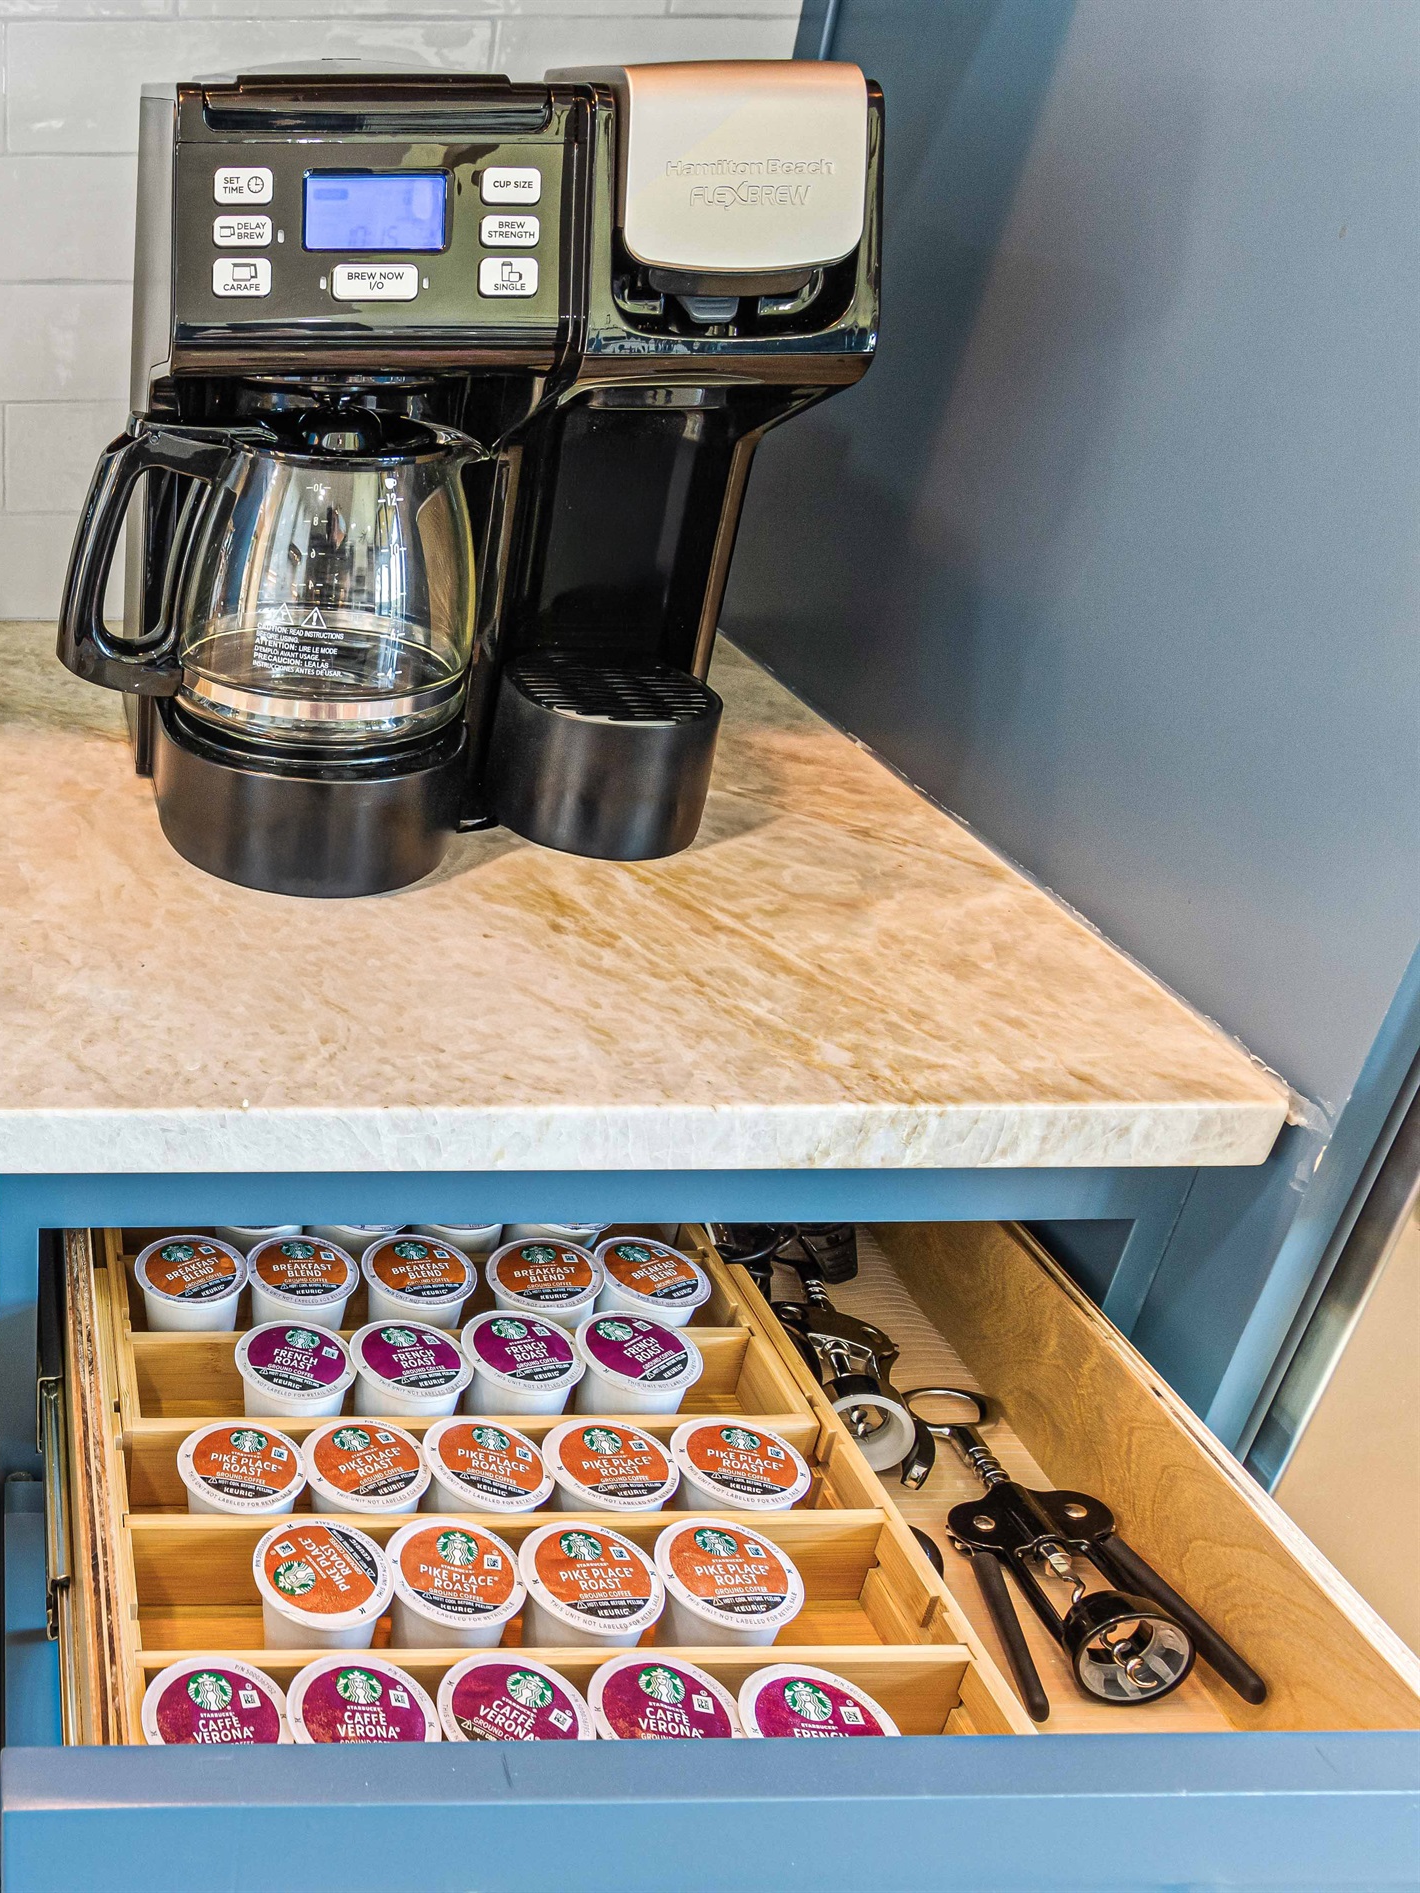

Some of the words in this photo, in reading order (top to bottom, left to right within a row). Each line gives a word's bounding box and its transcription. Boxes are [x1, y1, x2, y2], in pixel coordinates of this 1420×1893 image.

[666, 159, 763, 177] Hamilton
[766, 158, 835, 176] Beach
[223, 176, 240, 185] SET
[493, 180, 511, 189] CUP
[514, 180, 533, 189] SIZE
[223, 186, 244, 194] TIME
[689, 180, 811, 211] FLEXBREW
[236, 222, 267, 232] DELAY
[498, 221, 525, 230] BREW
[236, 230, 265, 240] BREW
[488, 230, 535, 240] STRENGTH
[347, 272, 376, 280] BREW
[379, 272, 404, 280] NOW
[223, 283, 260, 292] CARAFE
[369, 281, 384, 290] I/O
[494, 282, 526, 292] SINGLE
[386, 493, 396, 506] 12
[289, 628, 304, 636] READ
[304, 631, 344, 640] INSTRUCTIONS
[255, 637, 297, 650] ATTENTION:
[254, 652, 303, 666] PRECAUCION:
[165, 1256, 220, 1281] BREAKFAST
[272, 1263, 332, 1272] BREAKFAST
[287, 1269, 322, 1278] BLEND
[391, 1262, 450, 1275] BREAKFAST
[513, 1266, 576, 1278] BREAKFAST
[631, 1260, 678, 1280] BREAKFAST
[184, 1266, 214, 1283] BLEND
[408, 1269, 442, 1280] BLEND
[530, 1274, 566, 1283] BLEND
[649, 1269, 678, 1282] BLEND
[504, 1341, 546, 1355] FRENCH
[622, 1337, 658, 1358] FRENCH
[635, 1343, 665, 1362] ROAST
[273, 1348, 318, 1365] FRENCH
[392, 1350, 434, 1363] FRENCH
[515, 1349, 549, 1362] ROAST
[274, 1357, 313, 1371] ROAST
[400, 1358, 436, 1369] ROAST
[210, 1452, 237, 1465] PIKE
[240, 1458, 278, 1473] PLACE
[338, 1458, 366, 1474] PIKE
[366, 1449, 399, 1464] PLACE
[458, 1448, 484, 1461] PIKE
[486, 1454, 525, 1472] PLACE
[582, 1459, 612, 1470] PIKE
[615, 1456, 650, 1466] PLACE
[706, 1449, 736, 1460] PIKE
[740, 1453, 779, 1471] PLACE
[222, 1462, 263, 1477] ROAST
[358, 1460, 395, 1478] ROAST
[472, 1460, 511, 1477] ROAST
[600, 1466, 640, 1476] ROAST
[722, 1460, 765, 1475] ROAST
[223, 1487, 254, 1497] KEURIG
[378, 1483, 405, 1495] KEURIG
[477, 1484, 508, 1496] KEURIG
[616, 1488, 648, 1497] KEURIG
[730, 1483, 763, 1494] KEURIG
[301, 1538, 331, 1568] PLACE
[320, 1544, 352, 1576] ROAST
[420, 1564, 449, 1580] PIKE
[452, 1573, 493, 1586] PLACE
[559, 1568, 590, 1582] PIKE
[592, 1568, 632, 1578] PLACE
[694, 1564, 726, 1576] PIKE
[727, 1564, 768, 1576] PLACE
[326, 1566, 351, 1592] PIKE
[579, 1578, 621, 1591] ROAST
[714, 1574, 758, 1586] ROAST
[434, 1578, 478, 1594] ROAST
[715, 1587, 744, 1595] GROUND
[440, 1604, 474, 1613] KEURIG
[598, 1608, 630, 1616] KEURIG
[701, 1605, 717, 1616] UNIT
[736, 1617, 765, 1625] LABELED
[767, 1614, 778, 1622] FOR
[473, 1716, 504, 1737] GROUND
[480, 1705, 535, 1740] VERONA
[638, 1718, 702, 1738] VERONA
[193, 1727, 253, 1744] VERONA
[337, 1724, 398, 1739] VERONA
